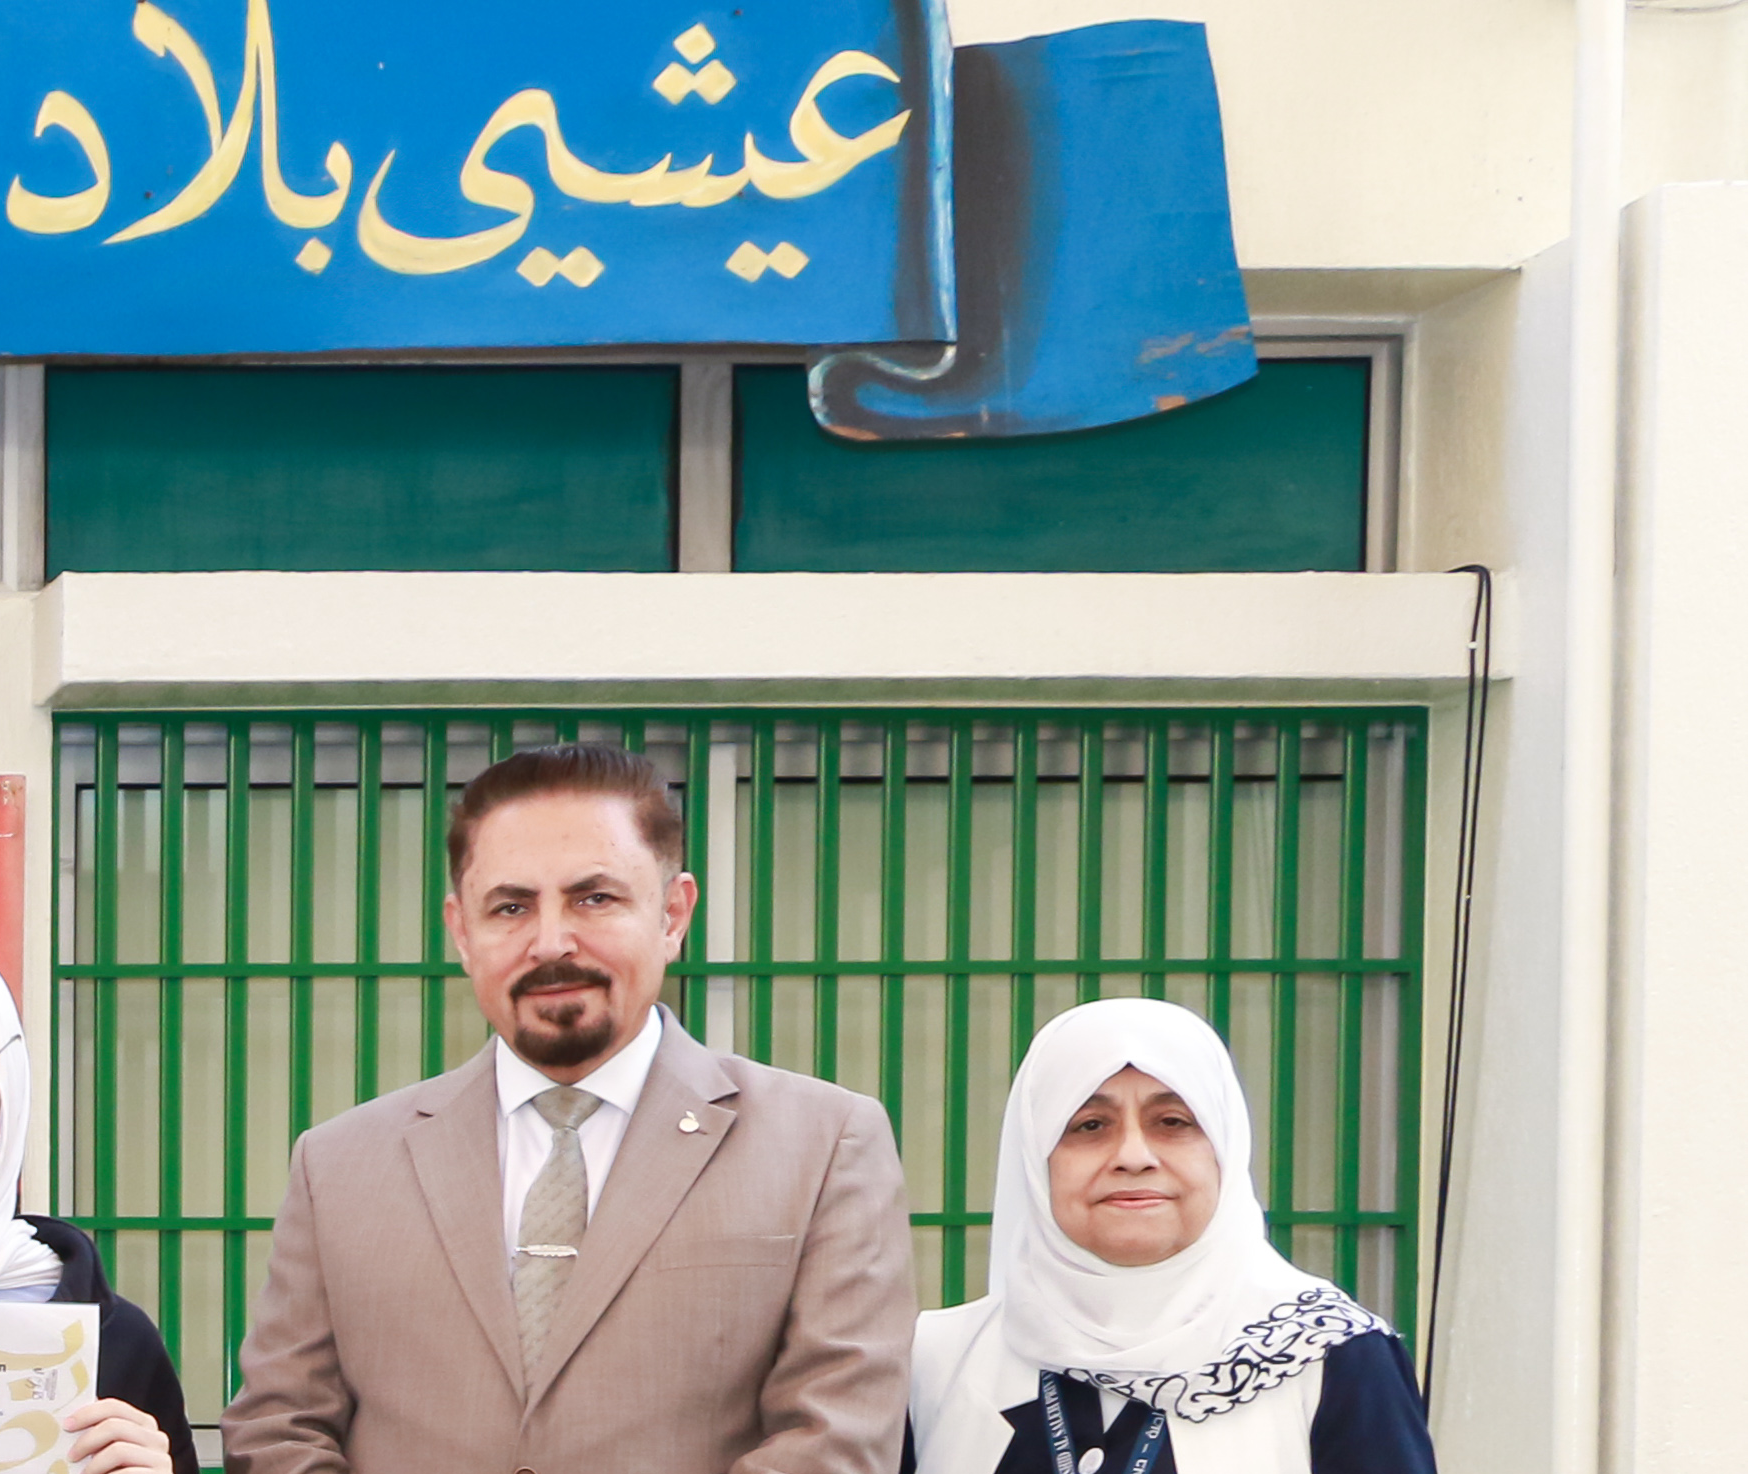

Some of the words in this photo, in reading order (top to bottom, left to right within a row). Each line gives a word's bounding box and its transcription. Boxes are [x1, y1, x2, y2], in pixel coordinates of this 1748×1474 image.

[357, 22, 913, 289] عيشي
[1046, 1402, 1065, 1439] SALEH
[1053, 1435, 1069, 1451] AL
